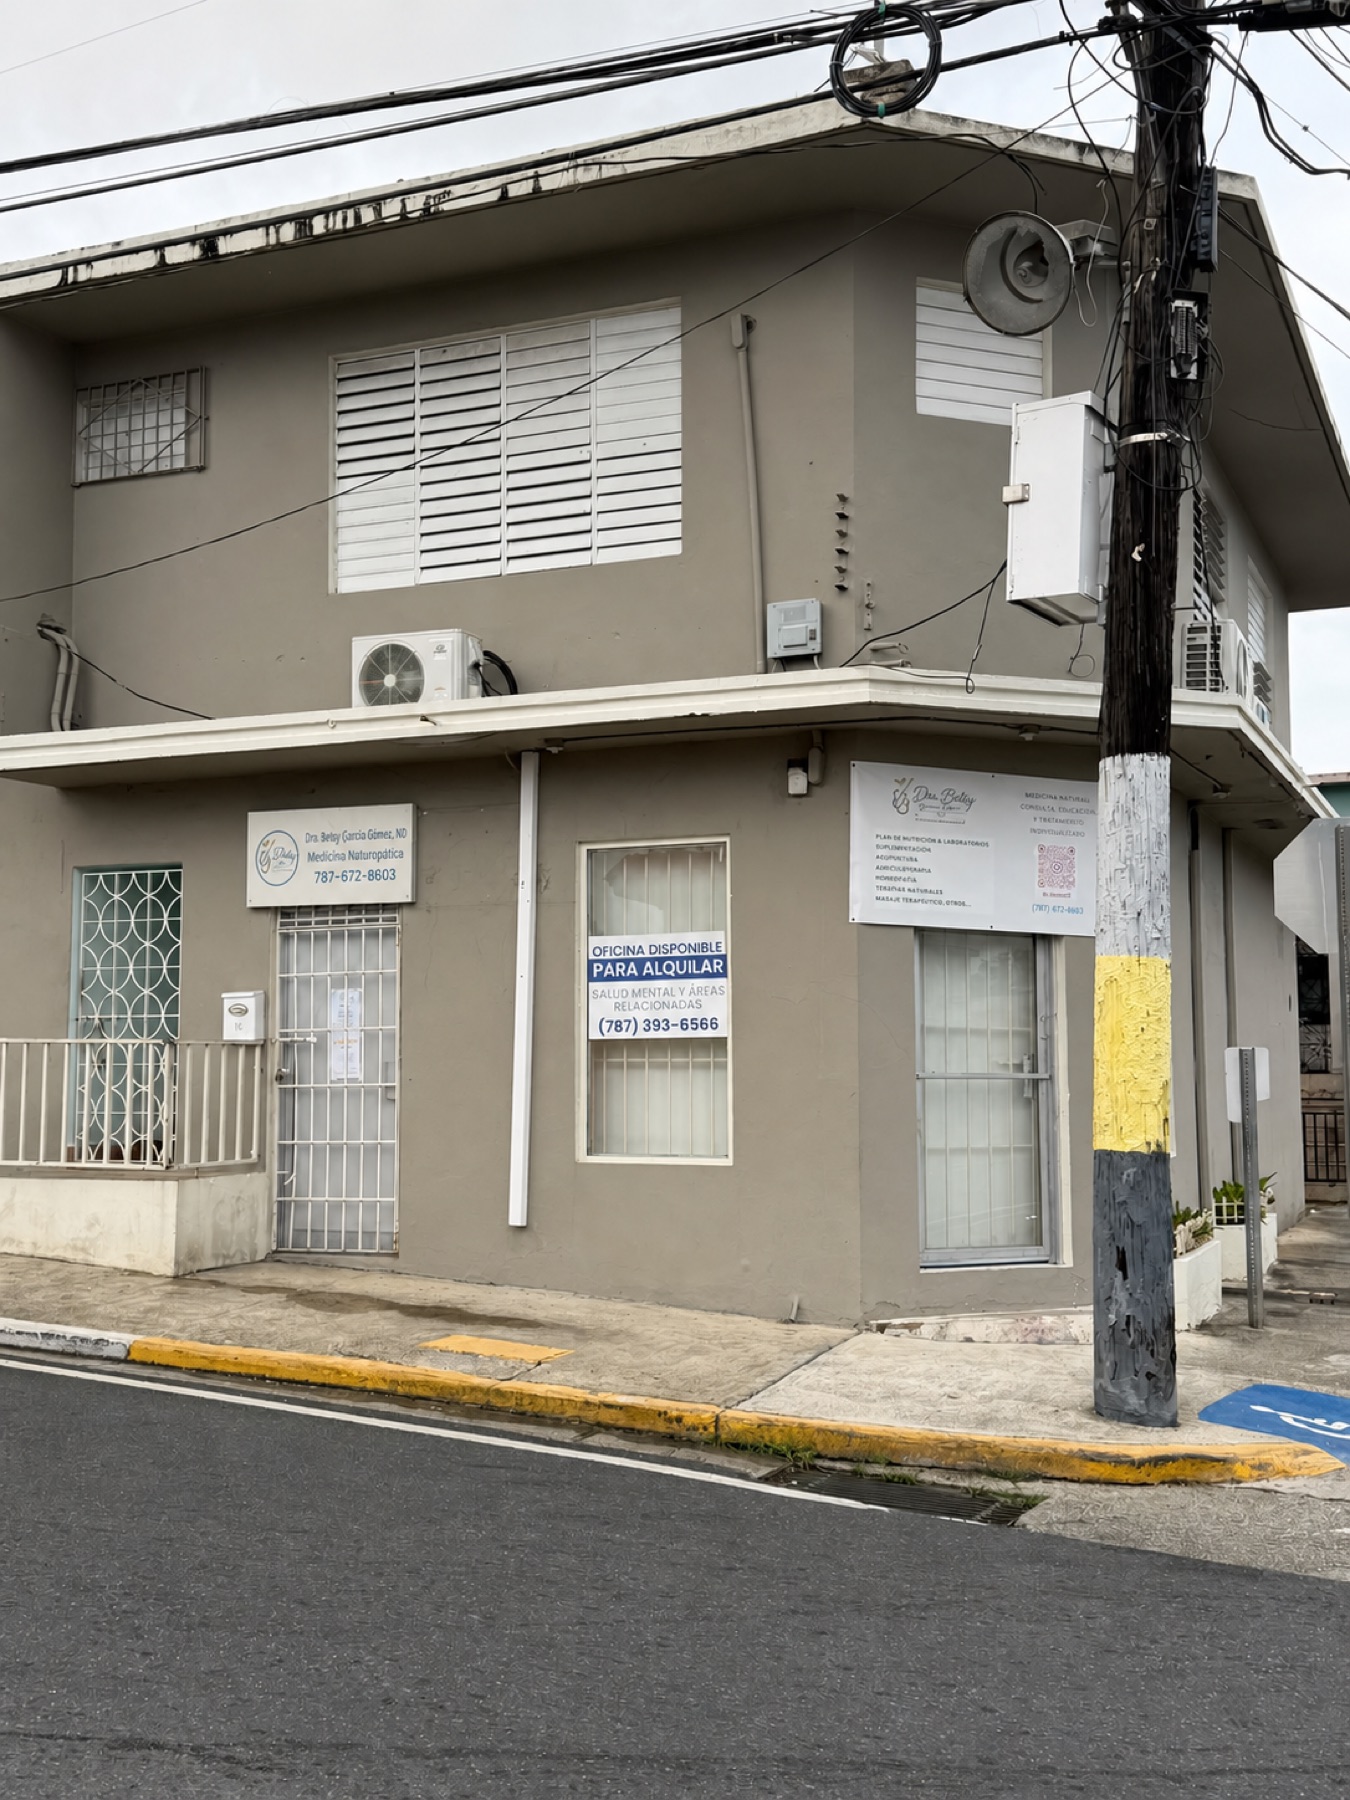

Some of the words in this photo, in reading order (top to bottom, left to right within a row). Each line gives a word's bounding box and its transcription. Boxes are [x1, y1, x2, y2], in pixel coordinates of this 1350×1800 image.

[395, 828, 408, 839] ND
[875, 833, 892, 841] PLAN
[943, 838, 990, 848] LABORATORIOS
[307, 849, 347, 863] Medicina
[347, 847, 404, 863] Naturopática
[313, 868, 397, 884] 787-672-8603
[875, 895, 901, 903] MASAJE
[907, 887, 943, 895] NATURALES
[592, 944, 646, 957] OFICINA
[648, 941, 723, 956] DISPONIBLE
[592, 961, 639, 978] PARA
[642, 958, 724, 977] ALQUILAR
[591, 988, 629, 1000] SALUD
[631, 986, 676, 999] MENTAL
[678, 986, 686, 997] Y
[688, 983, 726, 997] ÁREAS
[613, 999, 703, 1012] RELACIONADAS
[598, 1016, 639, 1037] (787)
[642, 1017, 720, 1032] 393-6566
